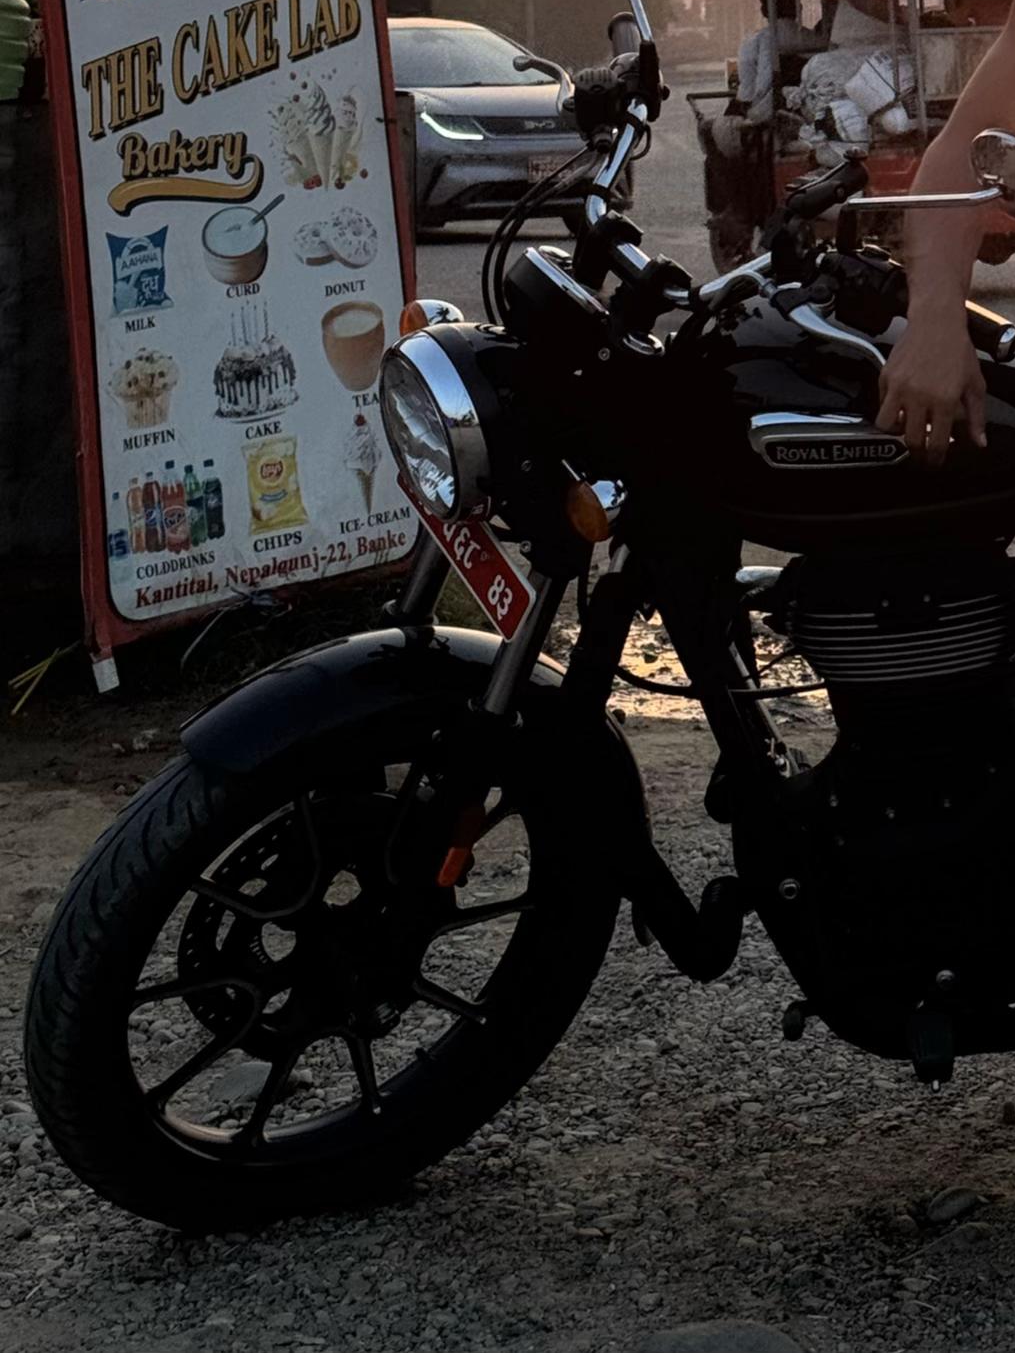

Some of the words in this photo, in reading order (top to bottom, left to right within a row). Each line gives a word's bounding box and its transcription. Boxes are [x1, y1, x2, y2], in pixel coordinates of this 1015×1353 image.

[81, 36, 163, 141] THE
[116, 128, 248, 181] Bakery
[120, 250, 160, 272] AAHANA
[225, 283, 261, 299] CURD
[324, 280, 366, 297] DONUT
[124, 316, 156, 334] MILK
[352, 392, 380, 408] TEA
[122, 428, 176, 452] MUFFIN
[245, 421, 282, 440] CAKE
[776, 445, 829, 462] ROYAL
[832, 444, 896, 461] ENFIELD
[367, 507, 411, 527] CREAM
[252, 531, 304, 553] CHIPS
[135, 570, 219, 609] Kantital,
[224, 539, 353, 589] Nepalgunj-22,
[356, 529, 407, 558] Banke
[136, 551, 215, 580] COLDDRINKS
